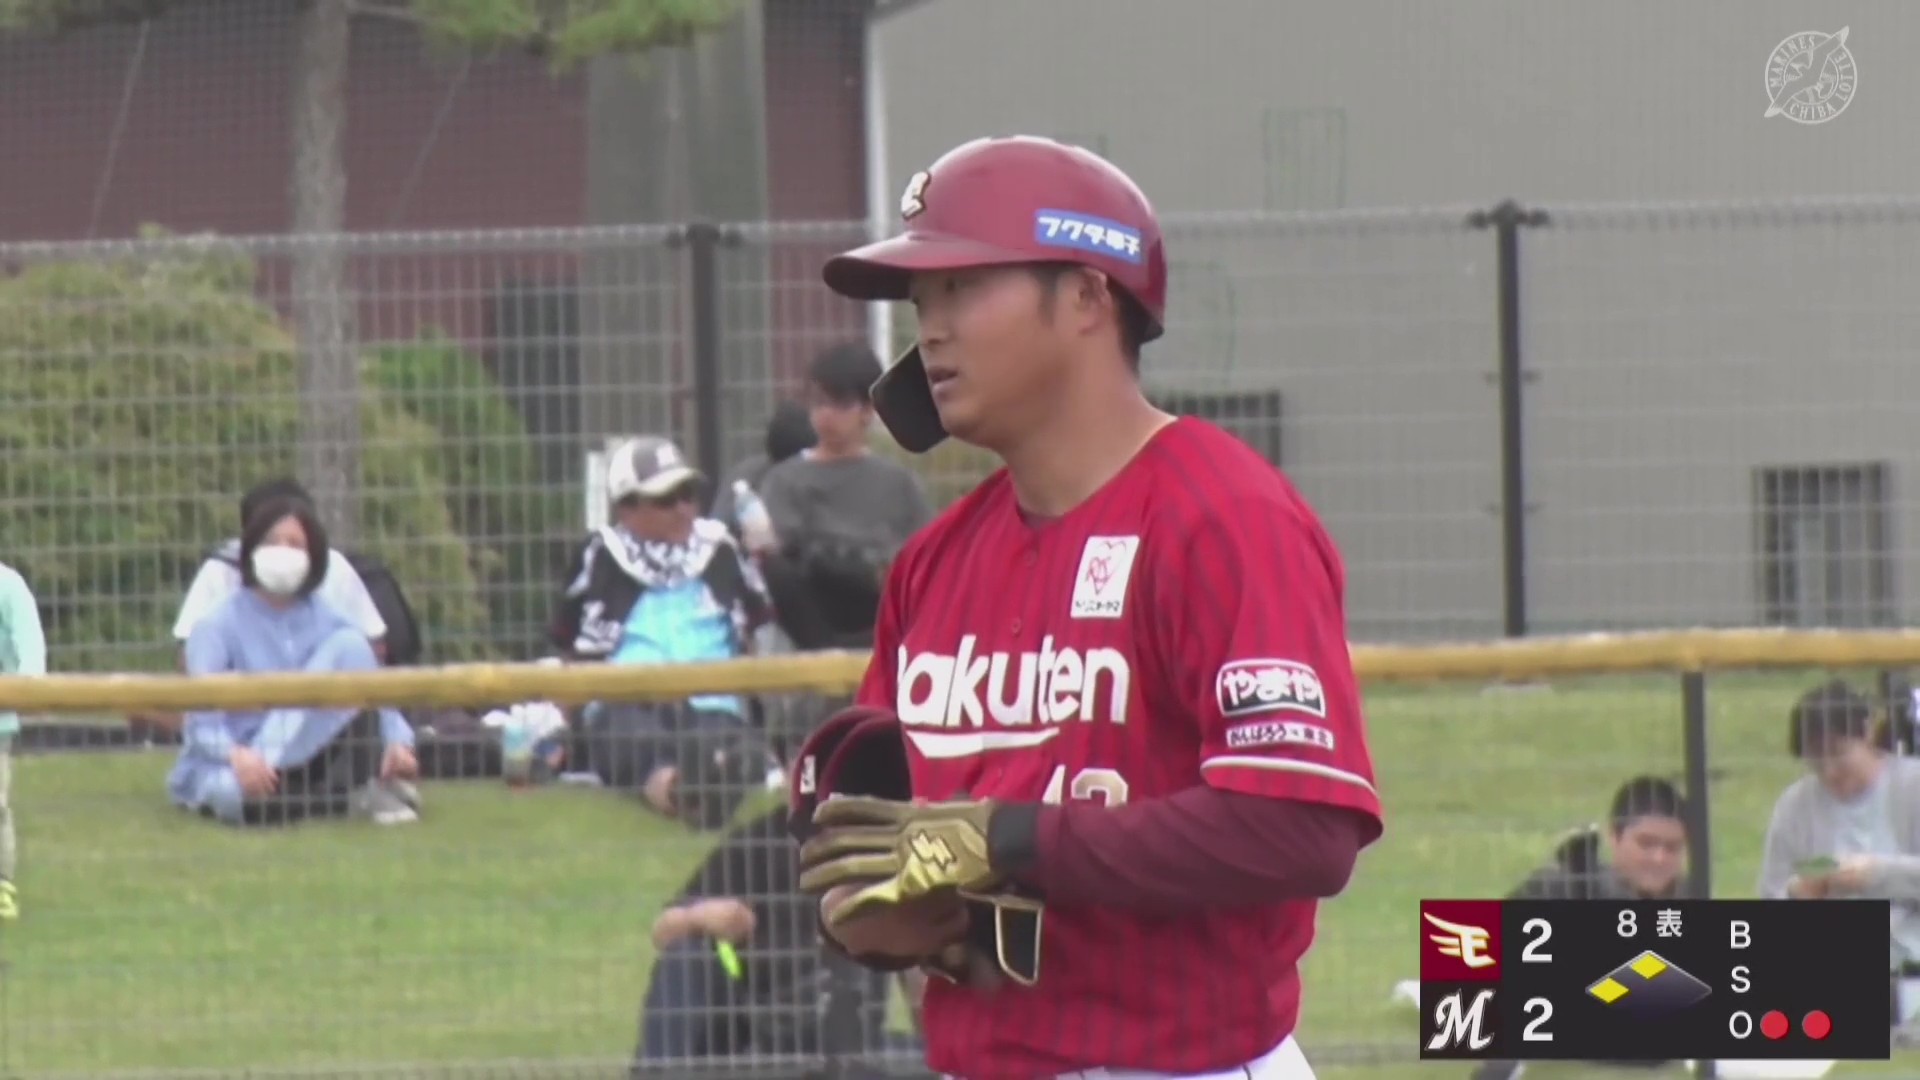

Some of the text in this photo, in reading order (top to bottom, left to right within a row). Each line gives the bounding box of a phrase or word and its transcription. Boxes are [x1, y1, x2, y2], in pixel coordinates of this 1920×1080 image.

[897, 634, 1131, 728] akuten
[1223, 667, 1320, 706] やまや
